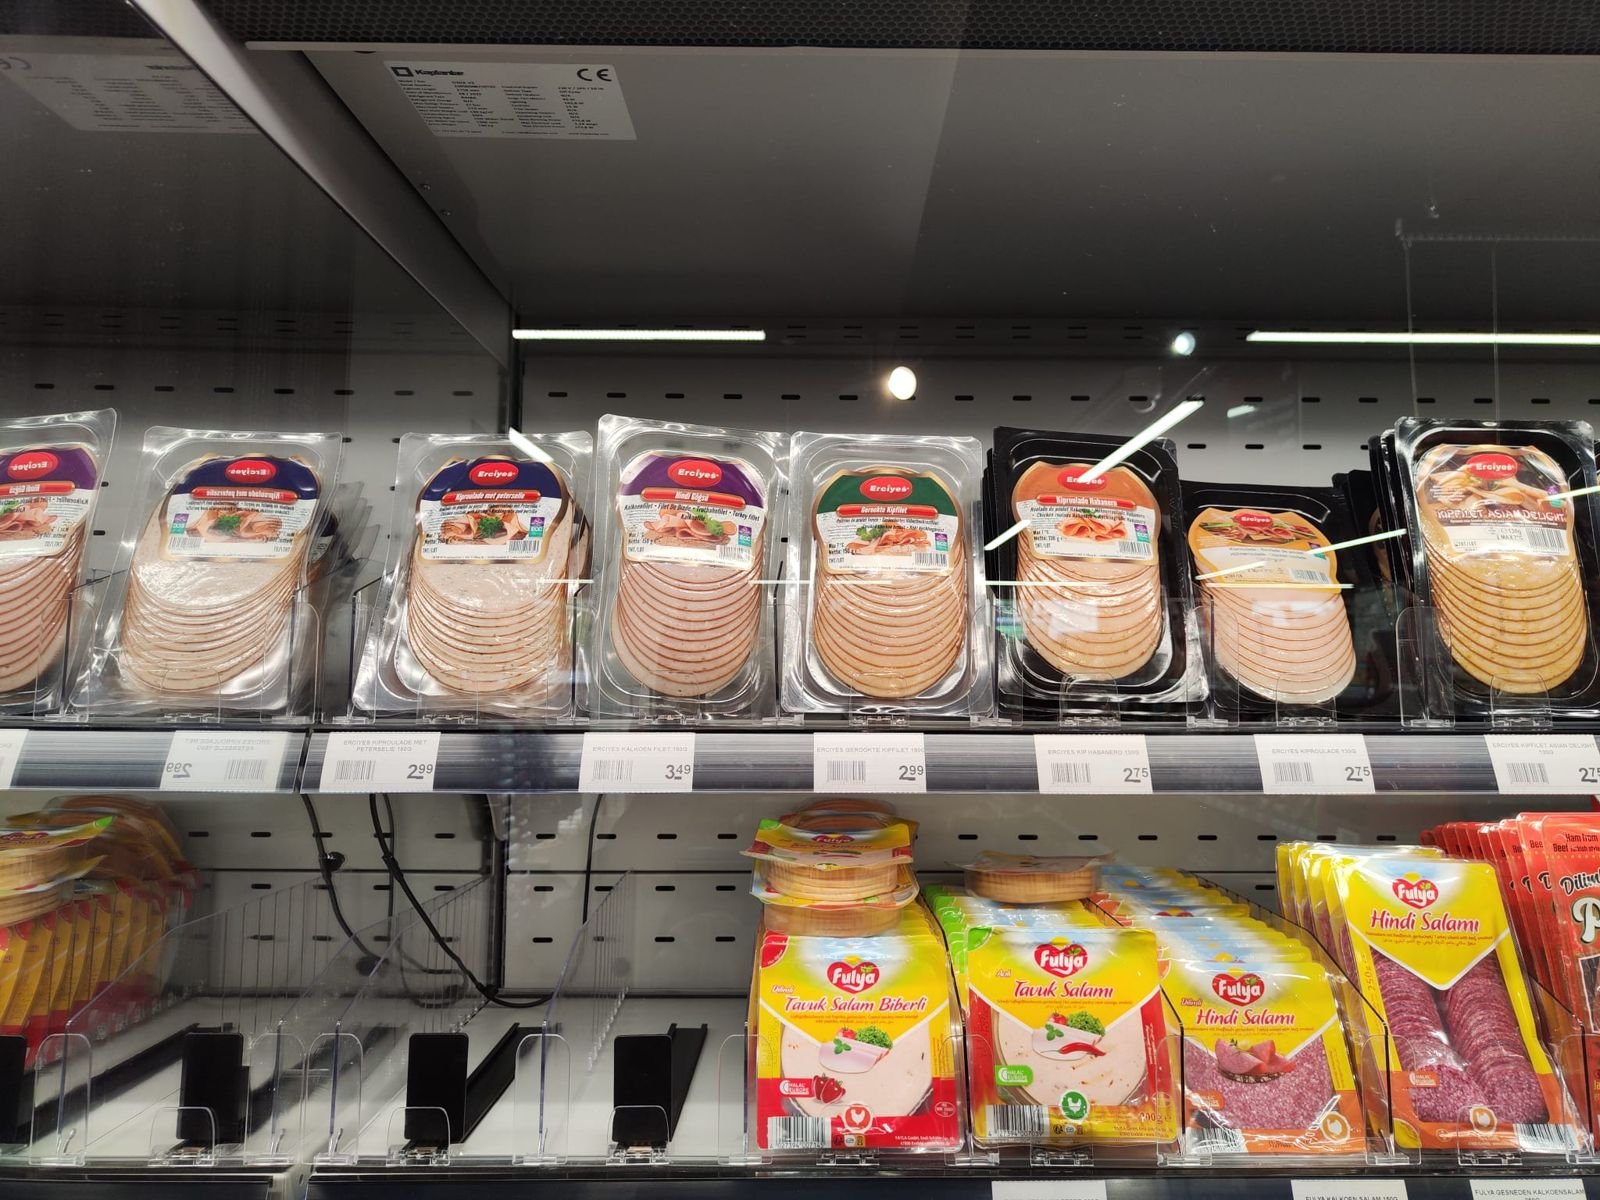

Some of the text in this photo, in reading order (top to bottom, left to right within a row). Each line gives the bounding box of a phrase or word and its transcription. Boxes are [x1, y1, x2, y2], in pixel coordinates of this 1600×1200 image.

[678, 469, 717, 479] Erciyes
[1476, 462, 1513, 471] Erciyes
[869, 485, 908, 493] Erciyes
[658, 503, 669, 511] Filet
[732, 510, 747, 520] Turkey
[1438, 509, 1483, 519] KIPFILET
[1523, 510, 1565, 522] DELIGHT
[1397, 884, 1436, 906] Fulya
[1371, 910, 1415, 929] Hindi
[1040, 949, 1084, 975] Fulya
[832, 965, 876, 991] Fulya
[1014, 980, 1058, 998] Tavuk
[1218, 980, 1261, 1002] Fulya
[784, 996, 928, 1013] Tavuk Salam Biberli
[1196, 1009, 1239, 1025] Hindi
